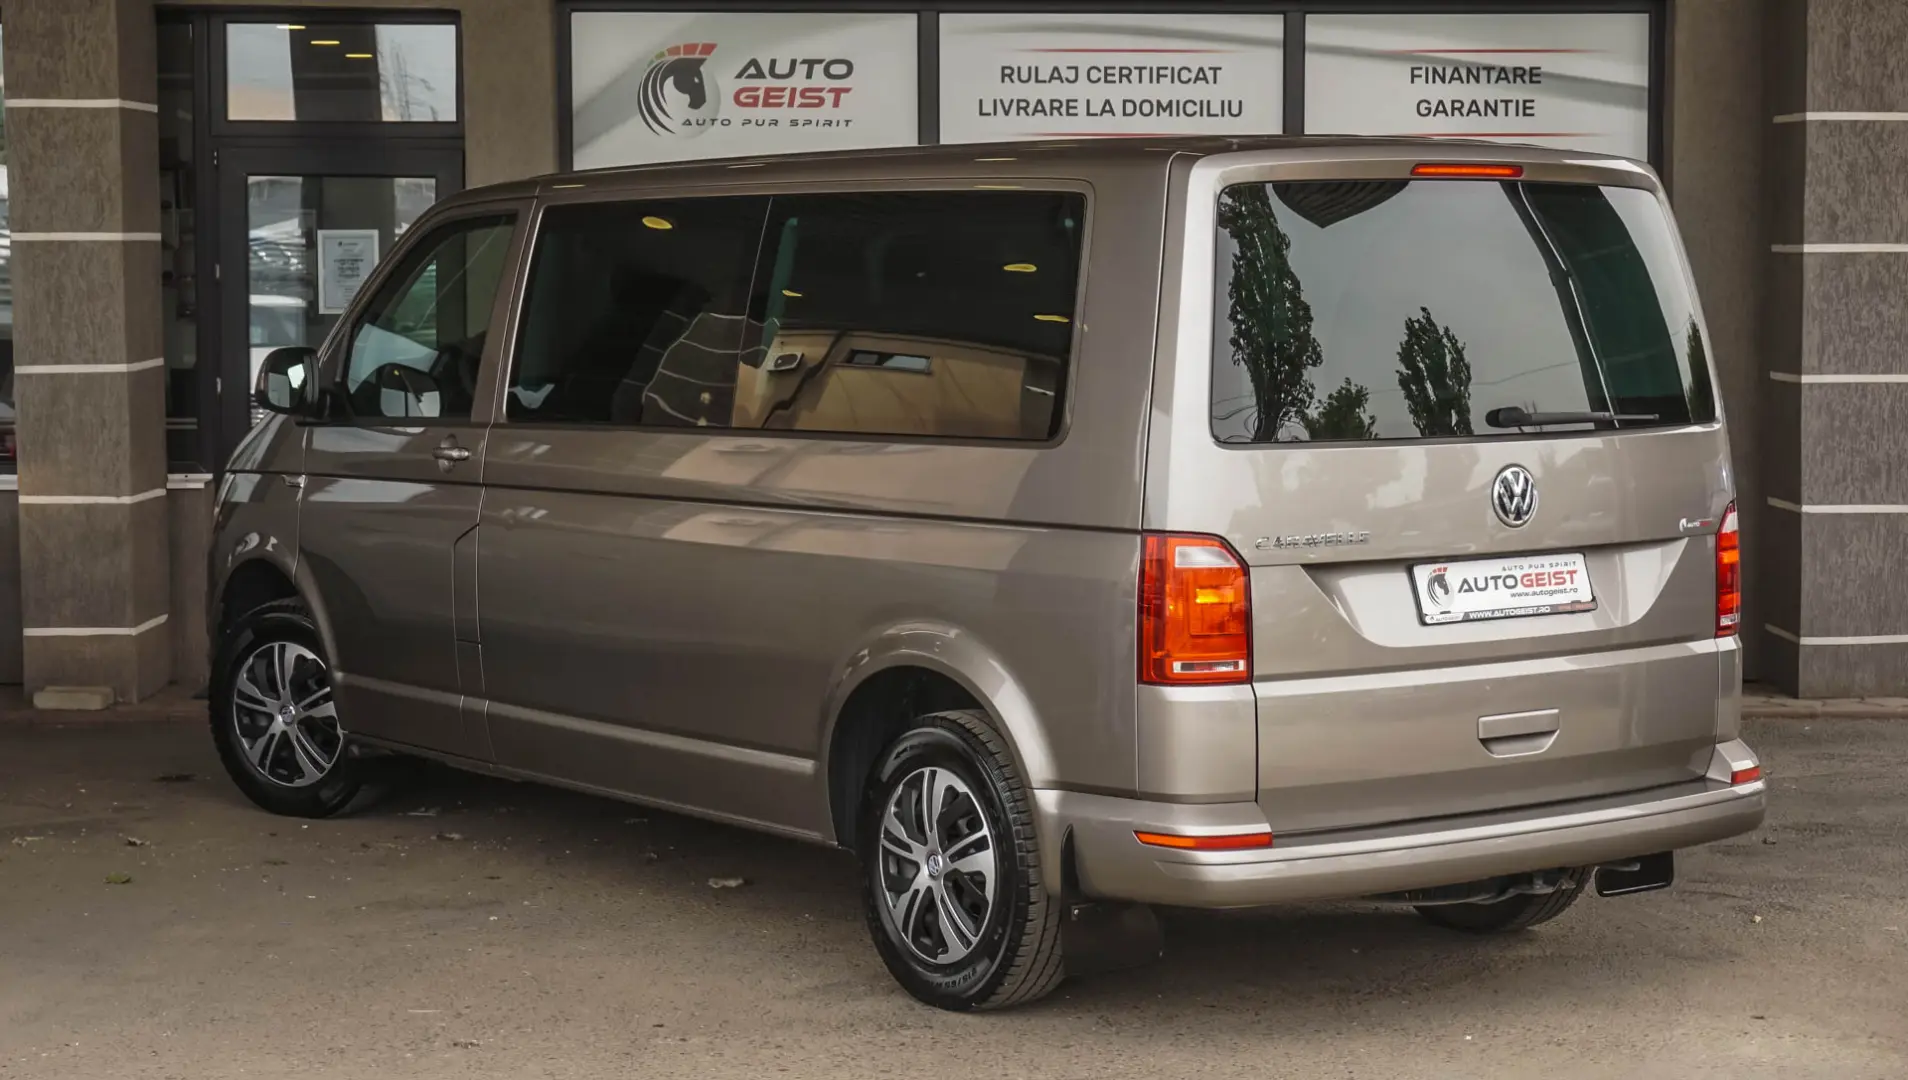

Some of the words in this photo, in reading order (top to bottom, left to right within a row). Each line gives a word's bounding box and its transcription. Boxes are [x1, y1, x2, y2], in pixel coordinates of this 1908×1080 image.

[734, 58, 854, 80] AUTO
[1000, 65, 1080, 84] RULAJ
[1086, 65, 1223, 85] CERTIFICAT
[1410, 66, 1542, 84] FINANTARE
[733, 86, 853, 108] GEIST
[978, 98, 1079, 117] LIVRARE
[1085, 98, 1117, 117] LA
[1122, 99, 1243, 118] DOMICILIU
[1416, 99, 1536, 117] GARANTIE
[681, 118, 732, 127] AUTO
[741, 118, 779, 127] PUR
[789, 118, 853, 128] SPIRIT
[1501, 564, 1525, 572] AUTO
[1528, 562, 1546, 570] PUR
[1549, 560, 1577, 569] SPIRIT
[1510, 587, 1579, 599] www.autogeist.ro
[1469, 606, 1551, 620] WWW.AUTOGEIST.RO
